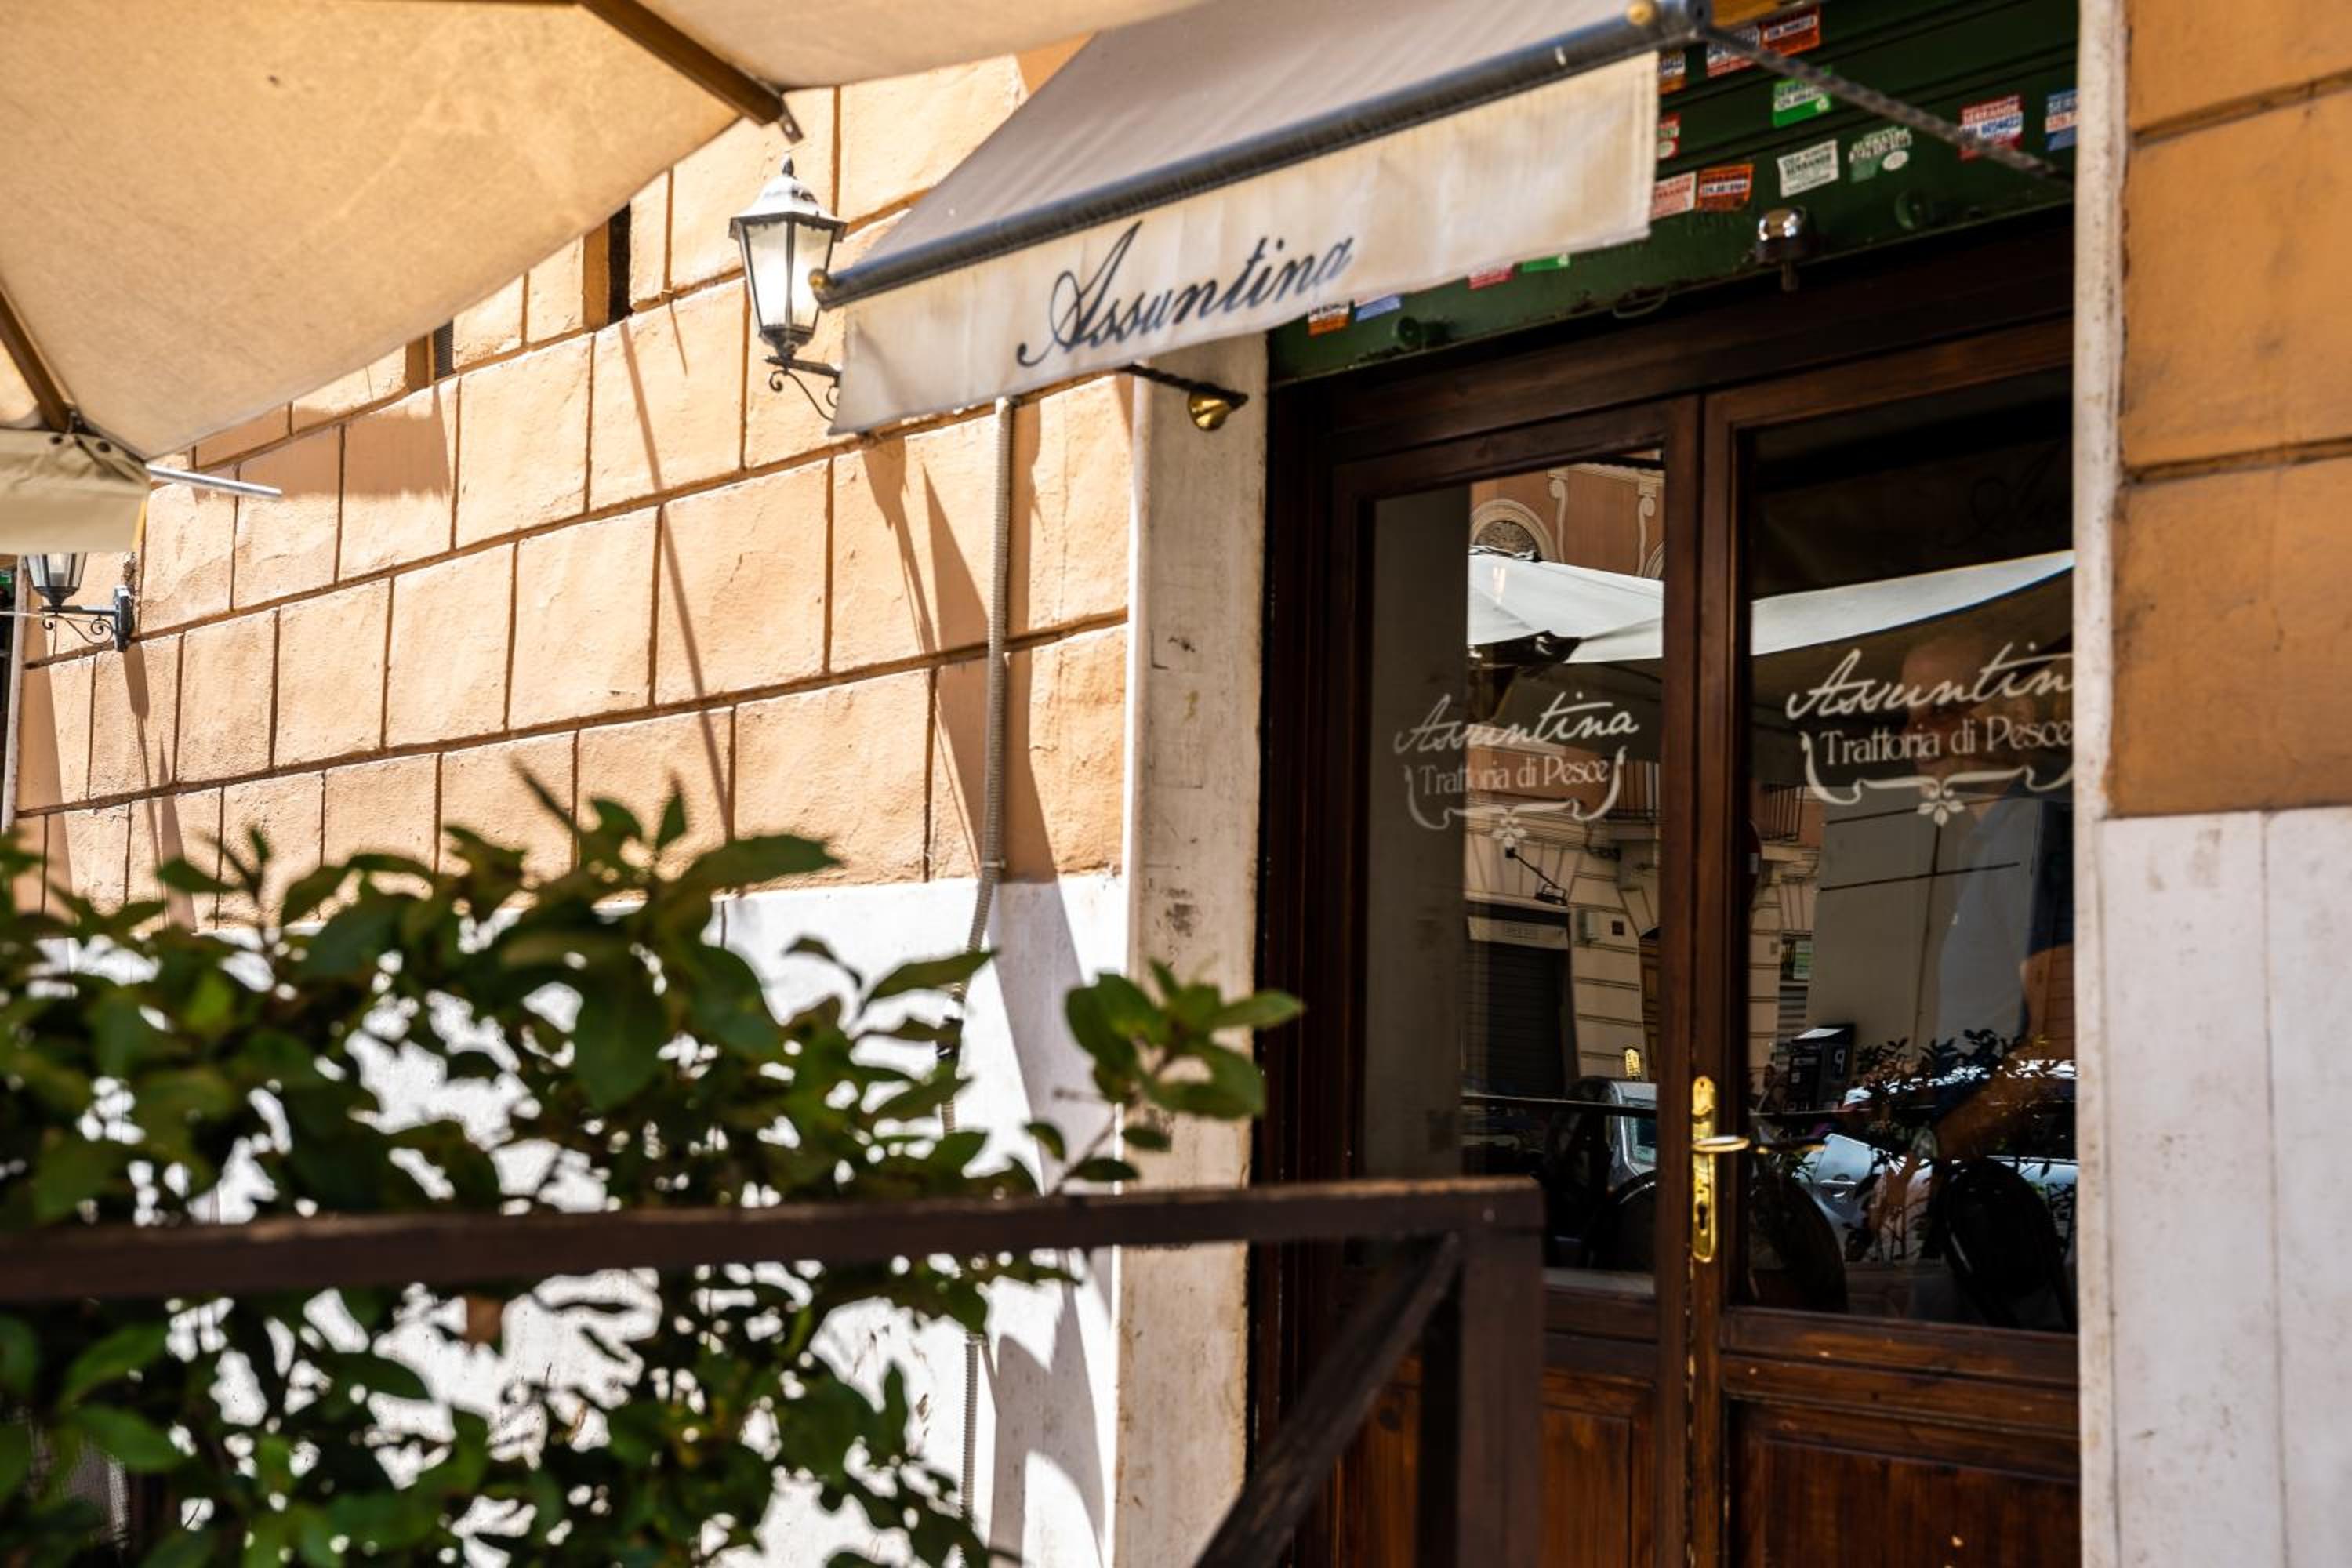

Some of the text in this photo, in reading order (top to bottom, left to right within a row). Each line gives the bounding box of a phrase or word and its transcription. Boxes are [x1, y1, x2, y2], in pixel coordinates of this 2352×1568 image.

[1016, 220, 1355, 367] Assuntina
[1785, 641, 2074, 720] Assuntin
[1393, 691, 1640, 754] Assuntina
[1819, 714, 2074, 766] Trattoria di Pesce
[1515, 757, 1537, 789] di
[1543, 755, 1610, 786] Pesce
